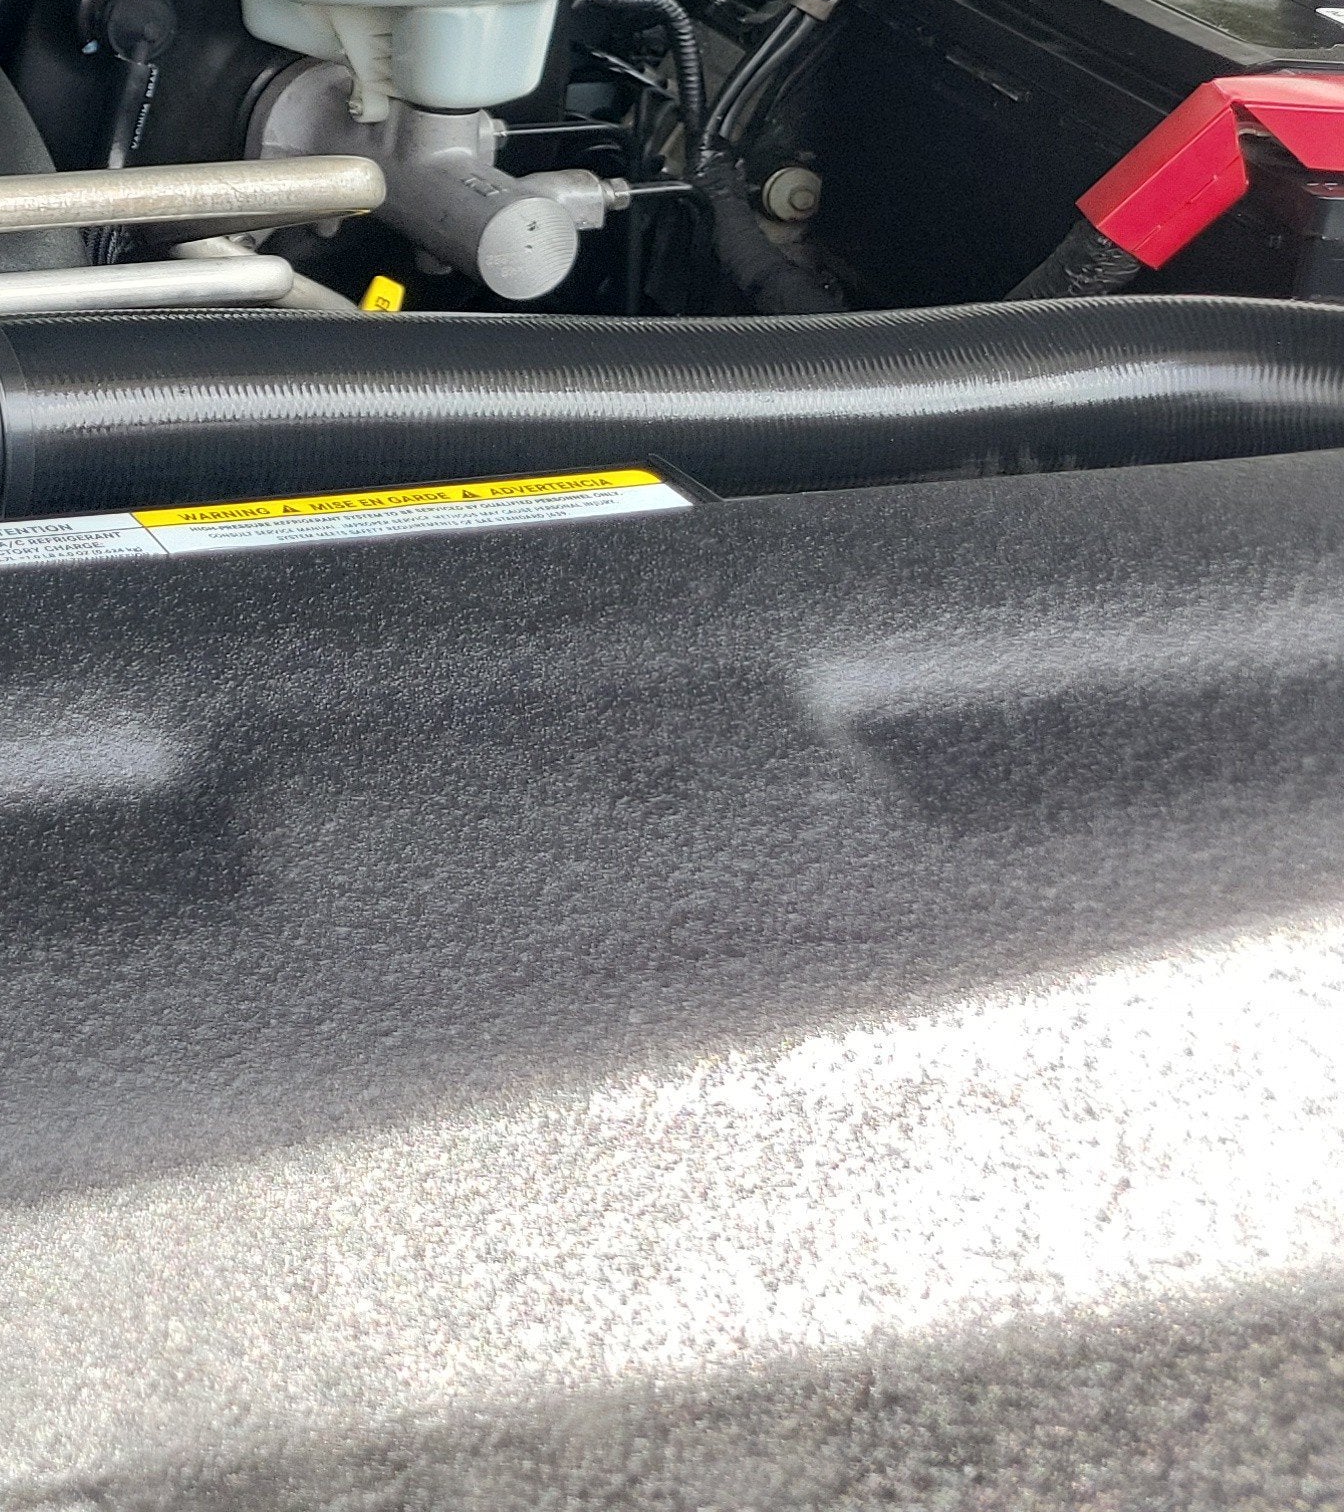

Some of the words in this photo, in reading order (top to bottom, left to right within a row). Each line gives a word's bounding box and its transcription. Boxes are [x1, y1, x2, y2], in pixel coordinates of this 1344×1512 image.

[130, 103, 151, 150] VACUUM
[179, 507, 270, 522] WARNING
[310, 500, 358, 512] MISE
[359, 498, 384, 508] EN
[387, 492, 450, 505] GARDE
[490, 478, 613, 496] ADVERTENCIA
[189, 522, 270, 532] HIGH-PRESSURE
[273, 516, 341, 526] REFRIGERANT
[343, 511, 382, 520] SYSTEM
[414, 505, 462, 514] SERVICED
[480, 499, 532, 509] QUALIFIED
[534, 493, 592, 503] PERSONNEL
[593, 490, 623, 499] ONLY.
[27, 531, 121, 546] REFRIGERANT
[208, 531, 253, 539] CONSULT
[256, 528, 293, 536] SERVICE
[341, 519, 389, 528] IMPROPER
[391, 516, 429, 524] SERVICE
[501, 506, 532, 514] CAUSE
[534, 502, 583, 512] PERSONAL
[276, 534, 313, 542] SYSTEM
[349, 527, 383, 536] SAFETY
[386, 520, 458, 532] REQUIREMENTS
[475, 516, 493, 524] SAE
[494, 513, 544, 523] STANDARD
[44, 541, 105, 552] CHARGE:
